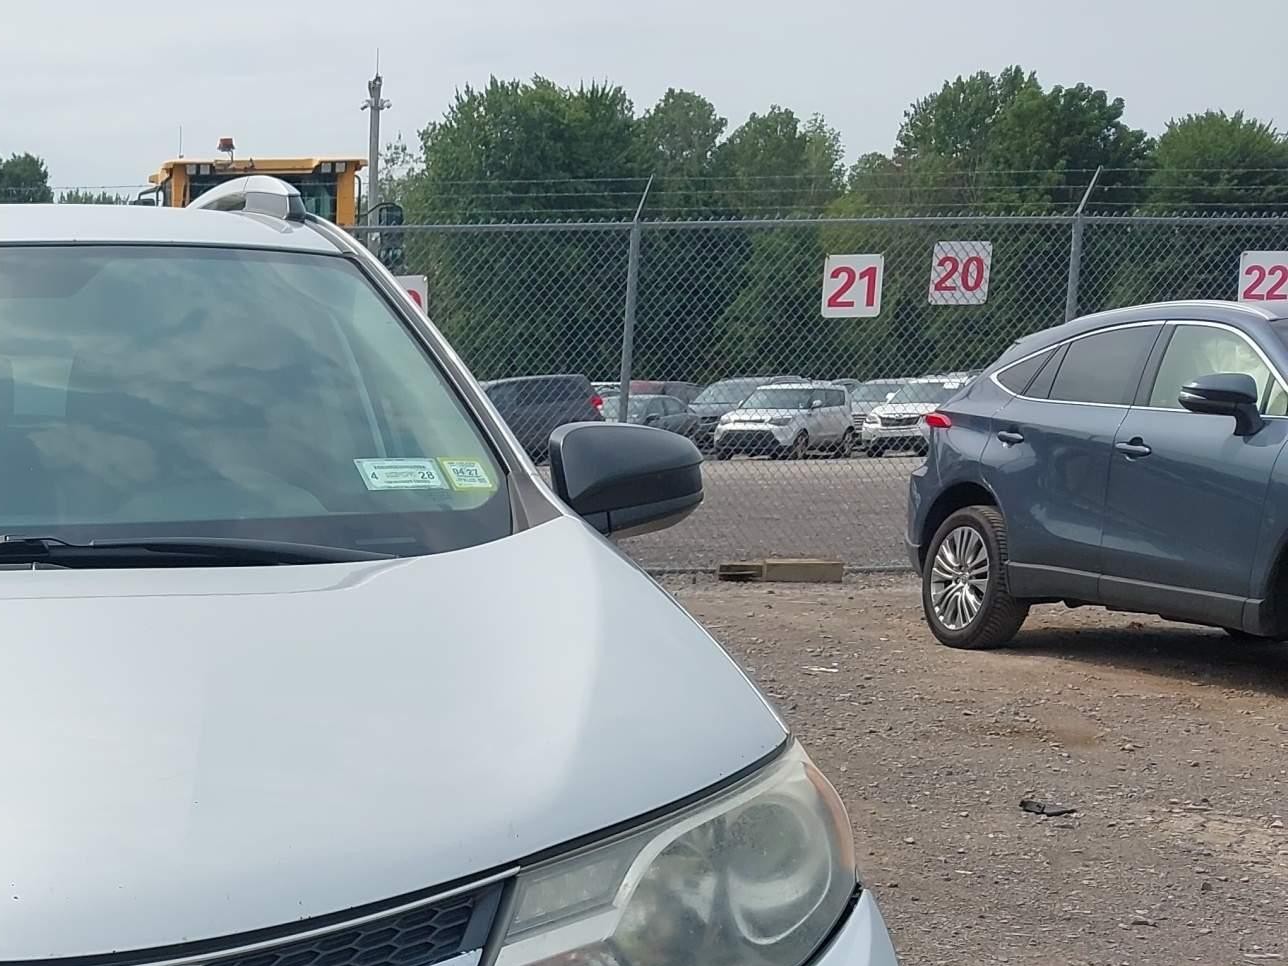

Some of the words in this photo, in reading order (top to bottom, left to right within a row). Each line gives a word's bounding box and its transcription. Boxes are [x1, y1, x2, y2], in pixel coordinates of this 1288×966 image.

[827, 266, 877, 308] 21
[934, 256, 984, 292] 20
[1243, 265, 1288, 299] 22
[370, 471, 379, 480] 4
[418, 471, 435, 480] 28
